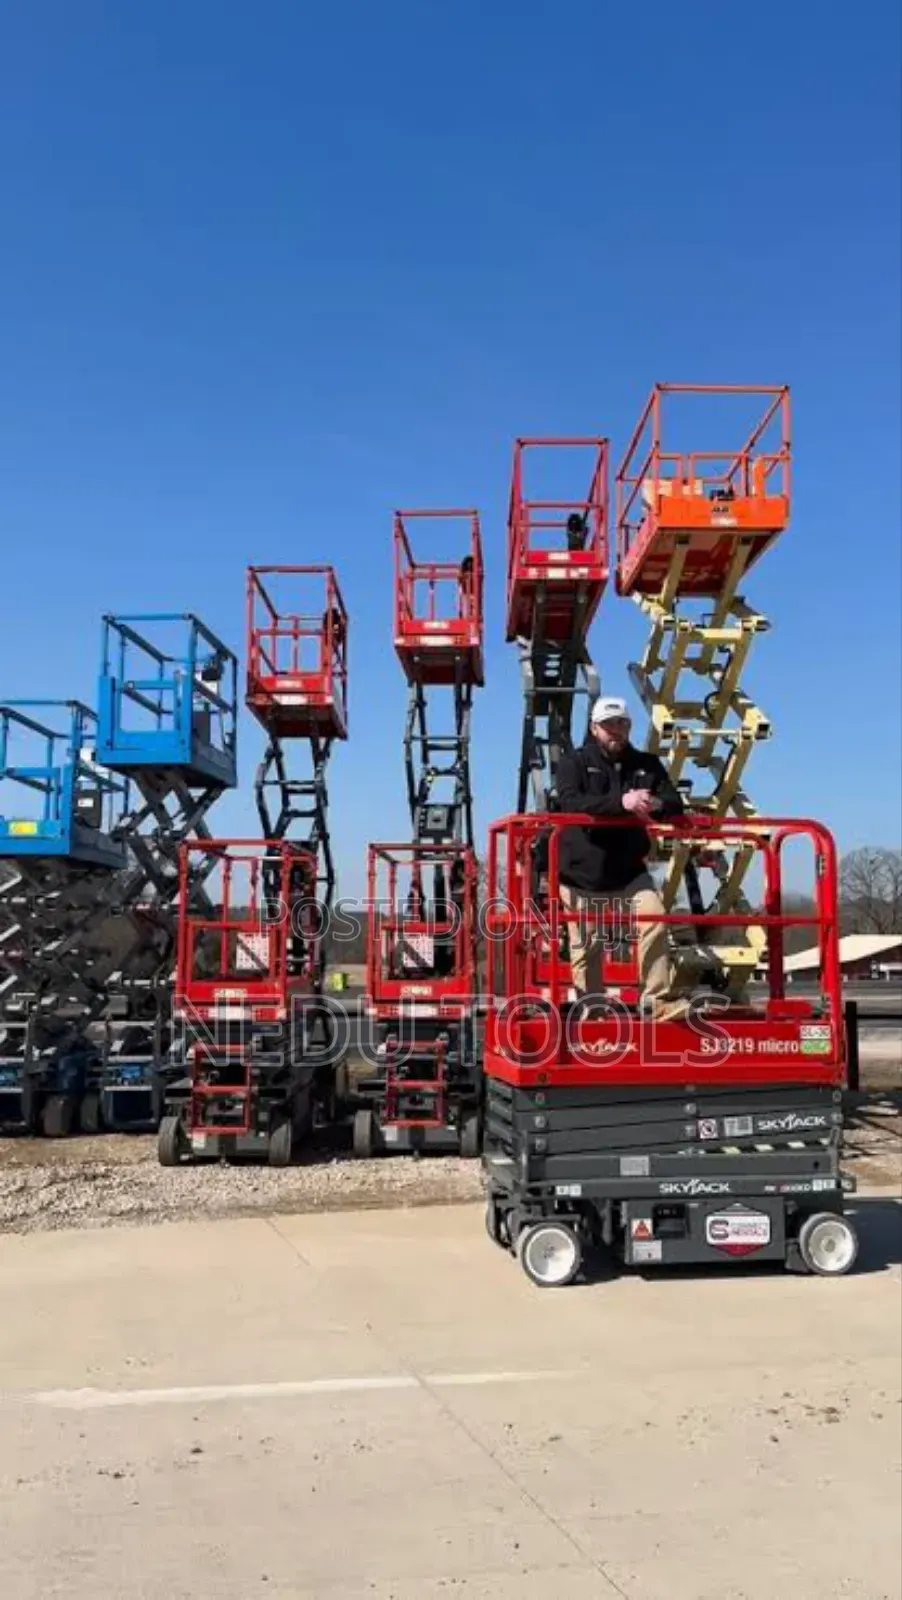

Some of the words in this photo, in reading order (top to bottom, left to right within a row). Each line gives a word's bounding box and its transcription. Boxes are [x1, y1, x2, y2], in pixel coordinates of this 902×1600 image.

[567, 1036, 638, 1055] SKYJACK
[699, 1037, 755, 1053] SJ3219
[757, 1037, 799, 1053] micro
[757, 1113, 827, 1131] SKYJACK
[658, 1178, 732, 1196] SKYJACK
